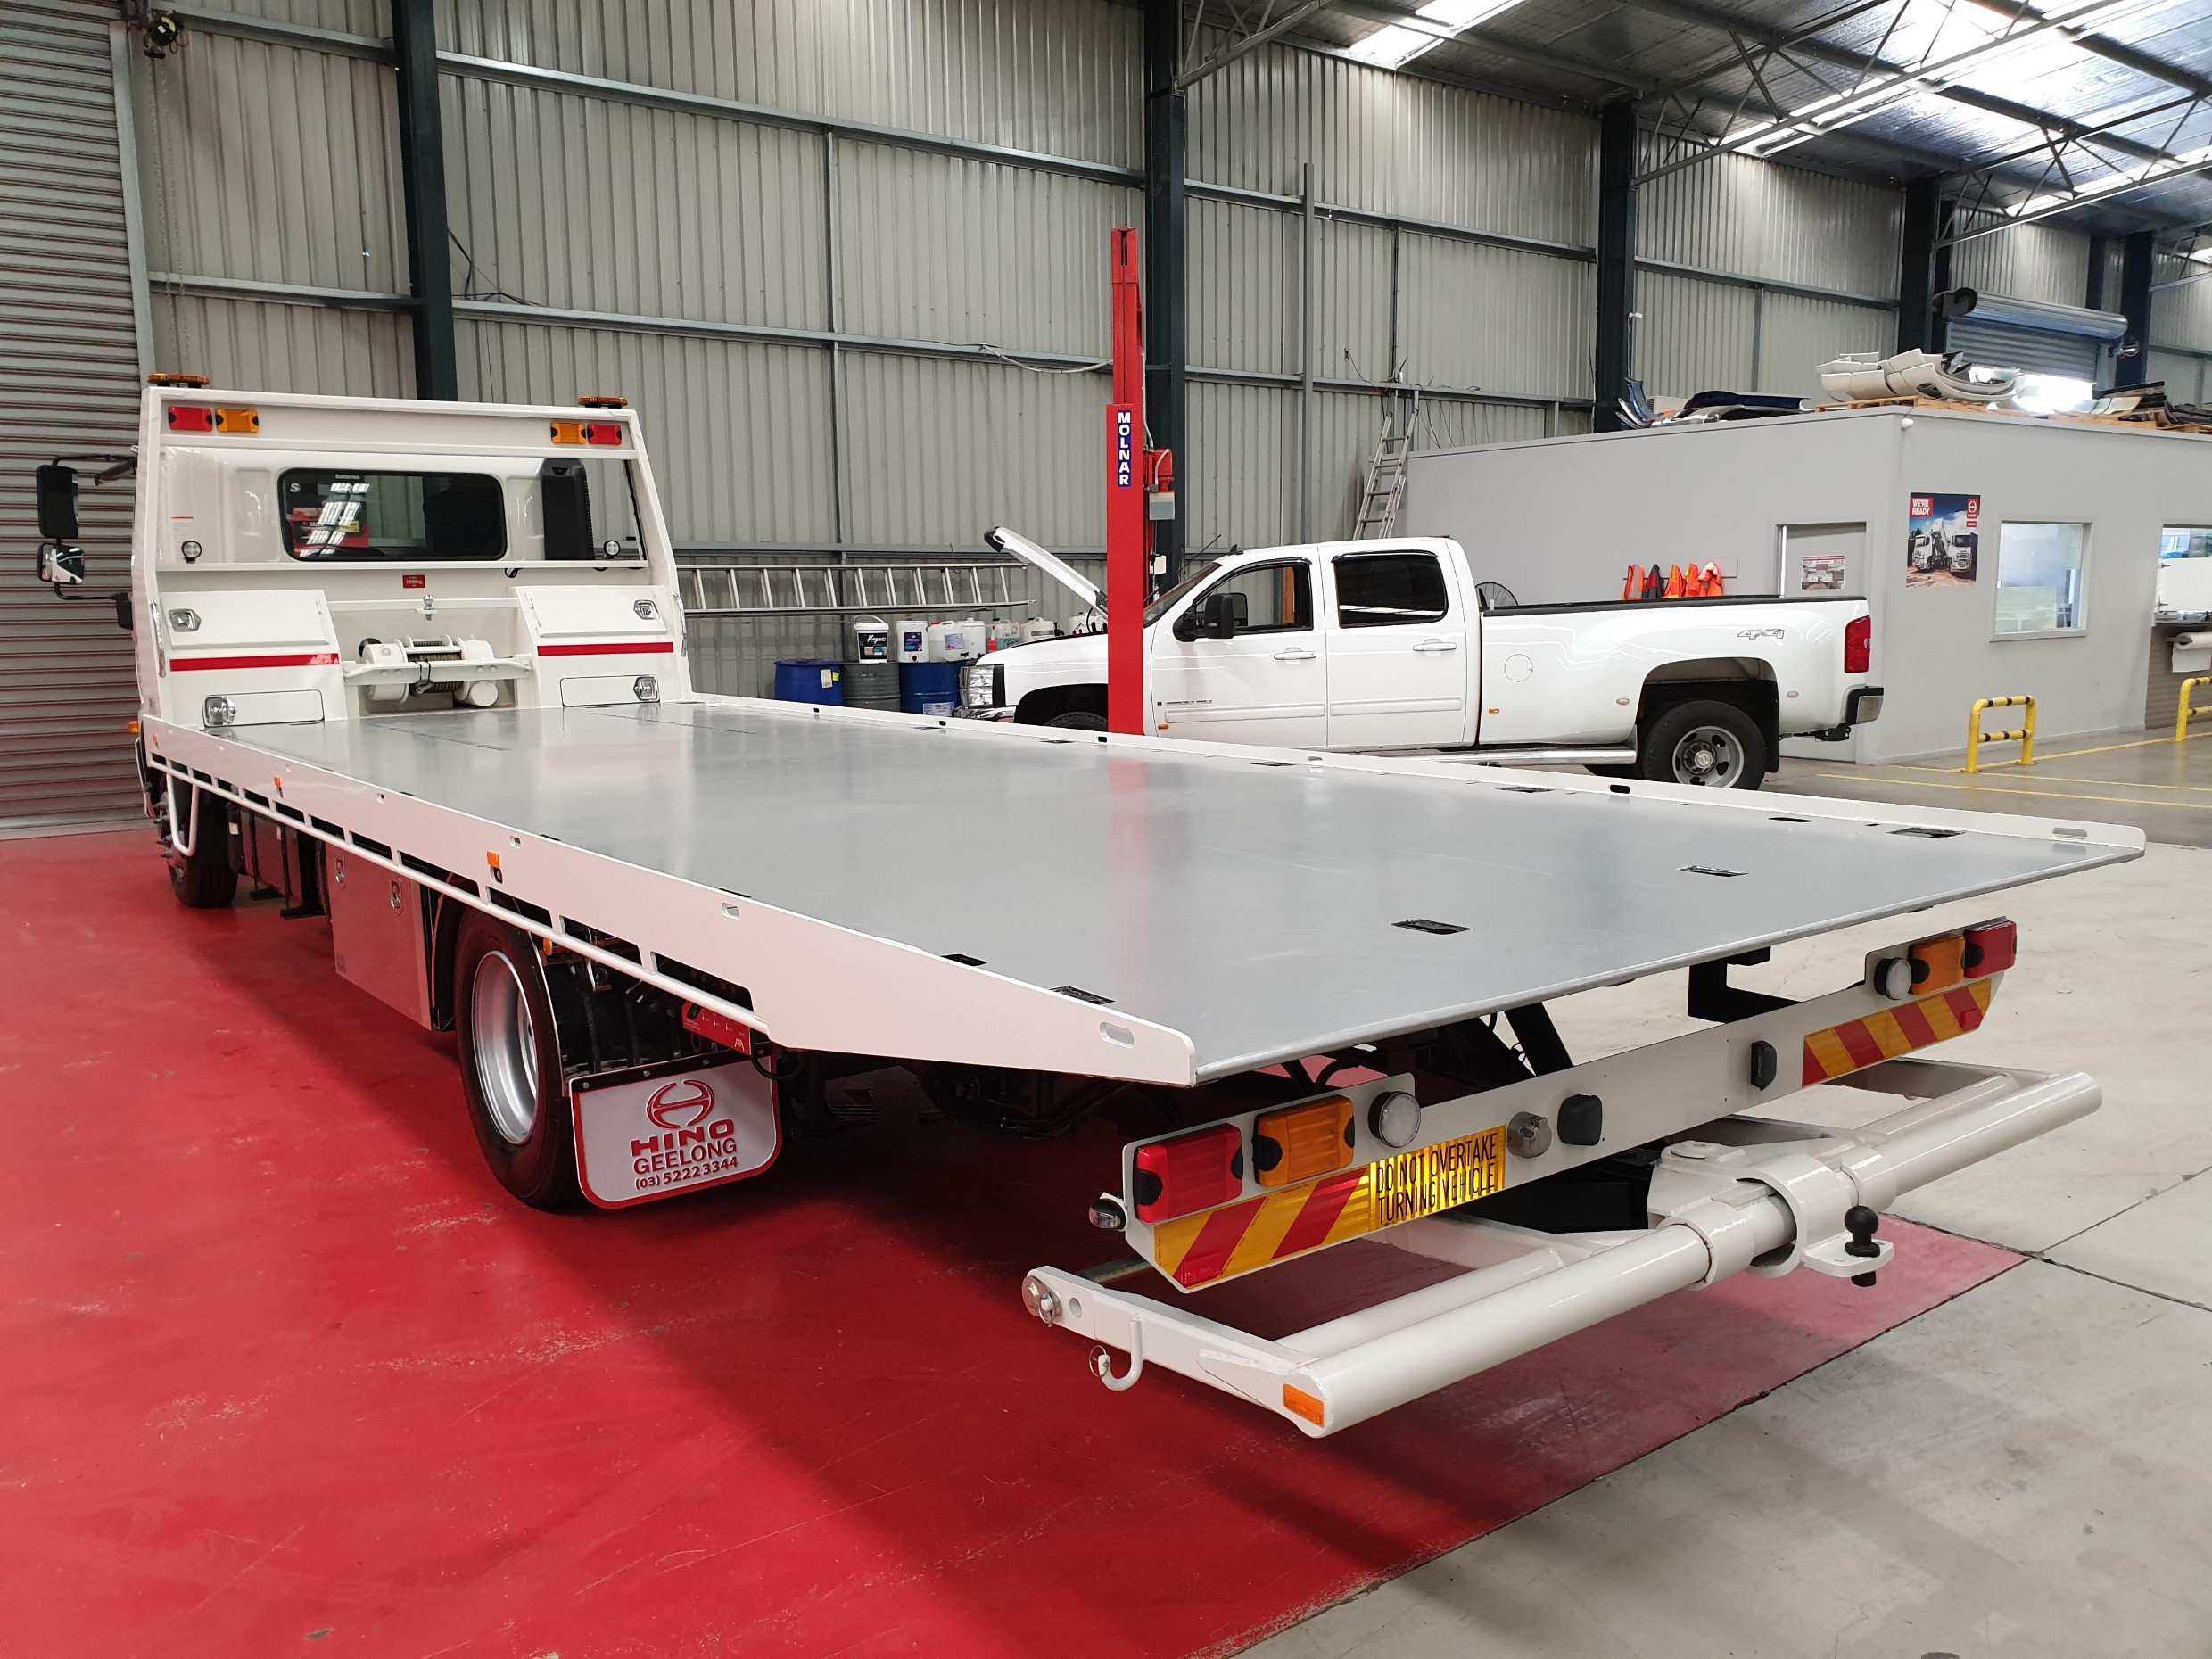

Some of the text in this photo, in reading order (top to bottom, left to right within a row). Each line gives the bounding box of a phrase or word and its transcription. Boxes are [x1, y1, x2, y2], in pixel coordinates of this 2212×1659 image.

[1118, 412, 1131, 485] MOLNAR
[1911, 499, 1929, 508] WE'RE
[1911, 507, 1930, 516] READY
[631, 1118, 735, 1157] HINO
[633, 1137, 738, 1176] GEELONG
[1376, 1132, 1498, 1194] DO NOT OVERTAKE
[635, 1175, 660, 1191] (03)
[1377, 1162, 1495, 1225] TURNING VEHICLE
